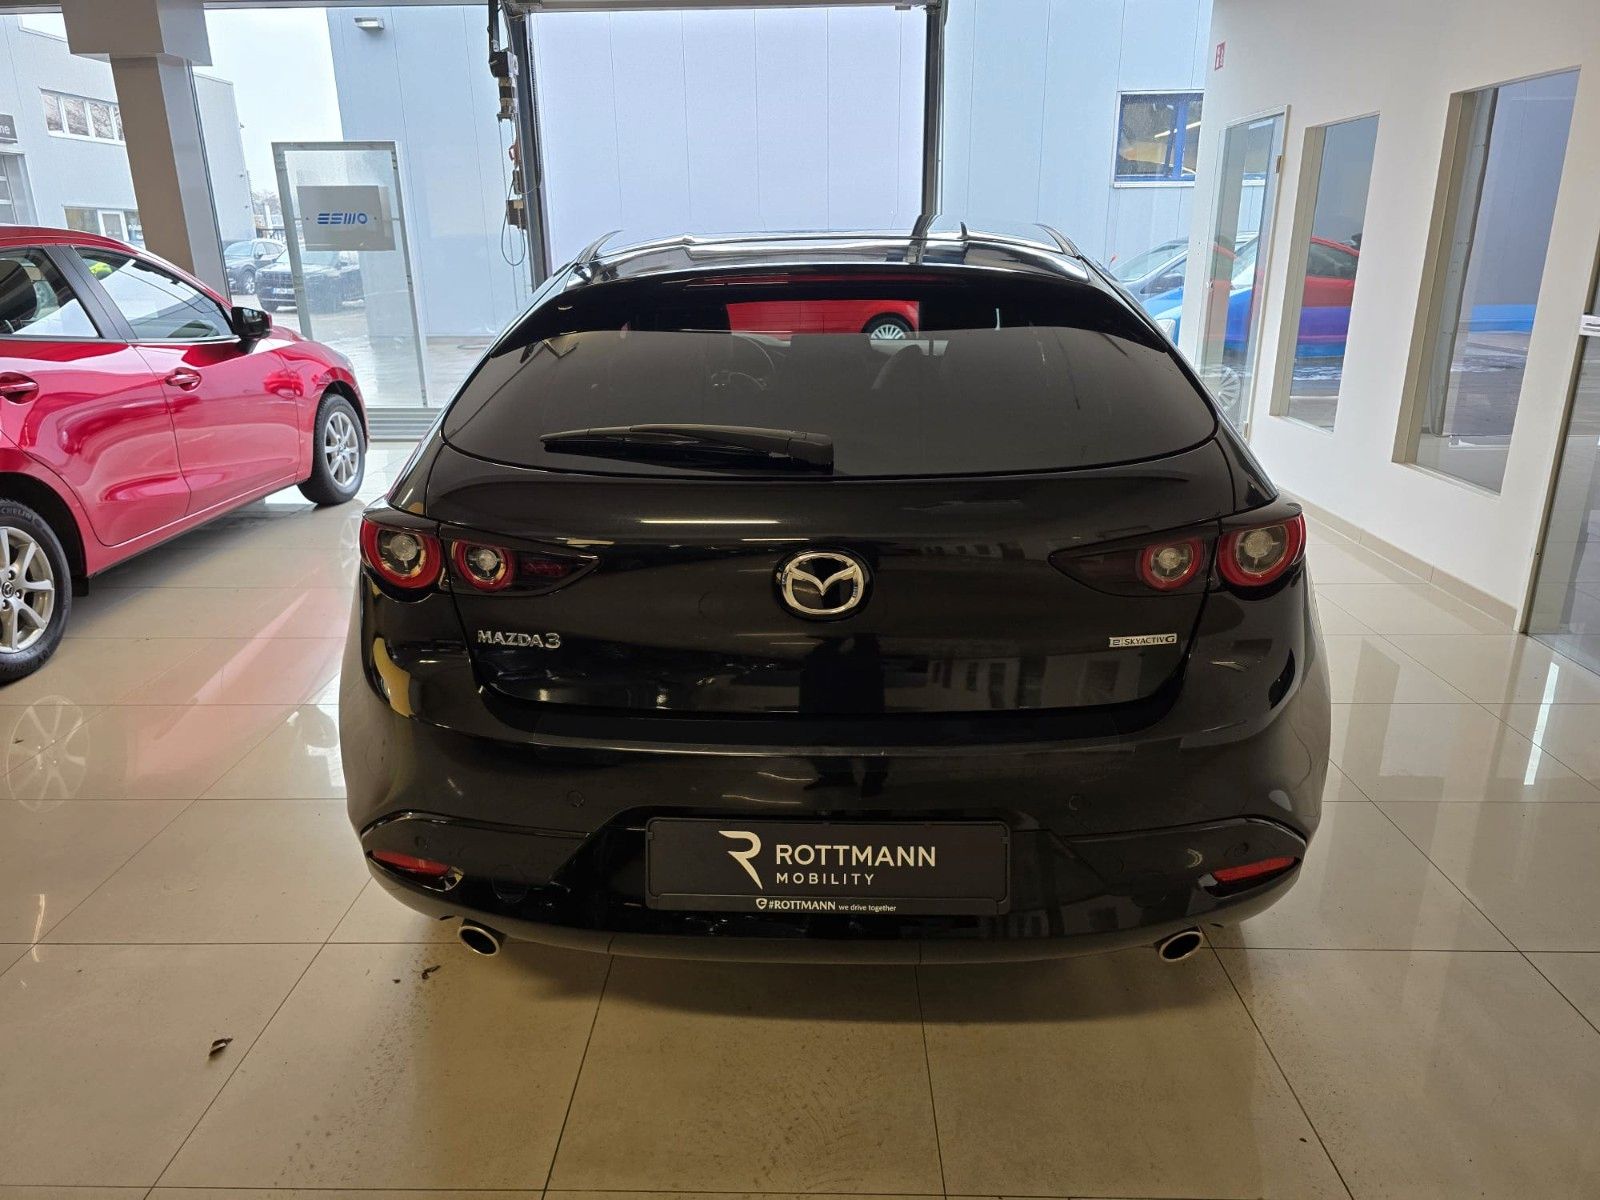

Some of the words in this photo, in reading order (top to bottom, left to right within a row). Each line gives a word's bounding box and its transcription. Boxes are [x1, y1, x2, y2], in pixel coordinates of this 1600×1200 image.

[776, 844, 936, 867] ROTTMANN
[776, 872, 875, 886] MOBILITY
[768, 900, 836, 910] #ROTTMANN
[850, 903, 867, 911] drive
[868, 904, 897, 913] together
